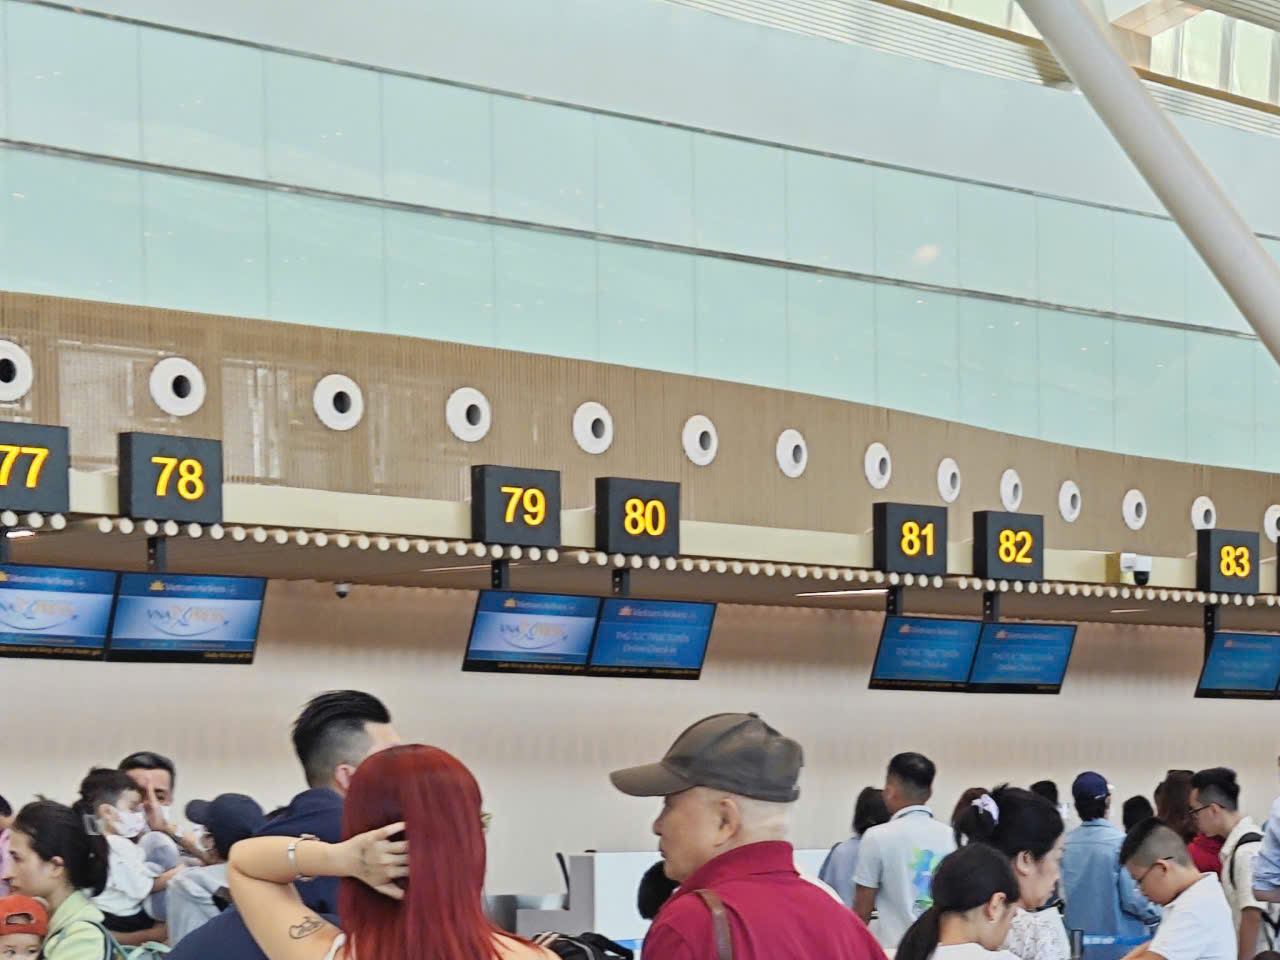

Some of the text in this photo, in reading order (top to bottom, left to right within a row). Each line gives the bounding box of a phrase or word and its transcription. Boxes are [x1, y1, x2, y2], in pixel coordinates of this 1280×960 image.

[0, 444, 49, 488] 77
[151, 456, 205, 501] 78
[500, 486, 546, 526] 79
[624, 498, 666, 536] 80
[900, 521, 935, 556] 81
[998, 529, 1033, 564] 82
[1220, 545, 1251, 578] 83
